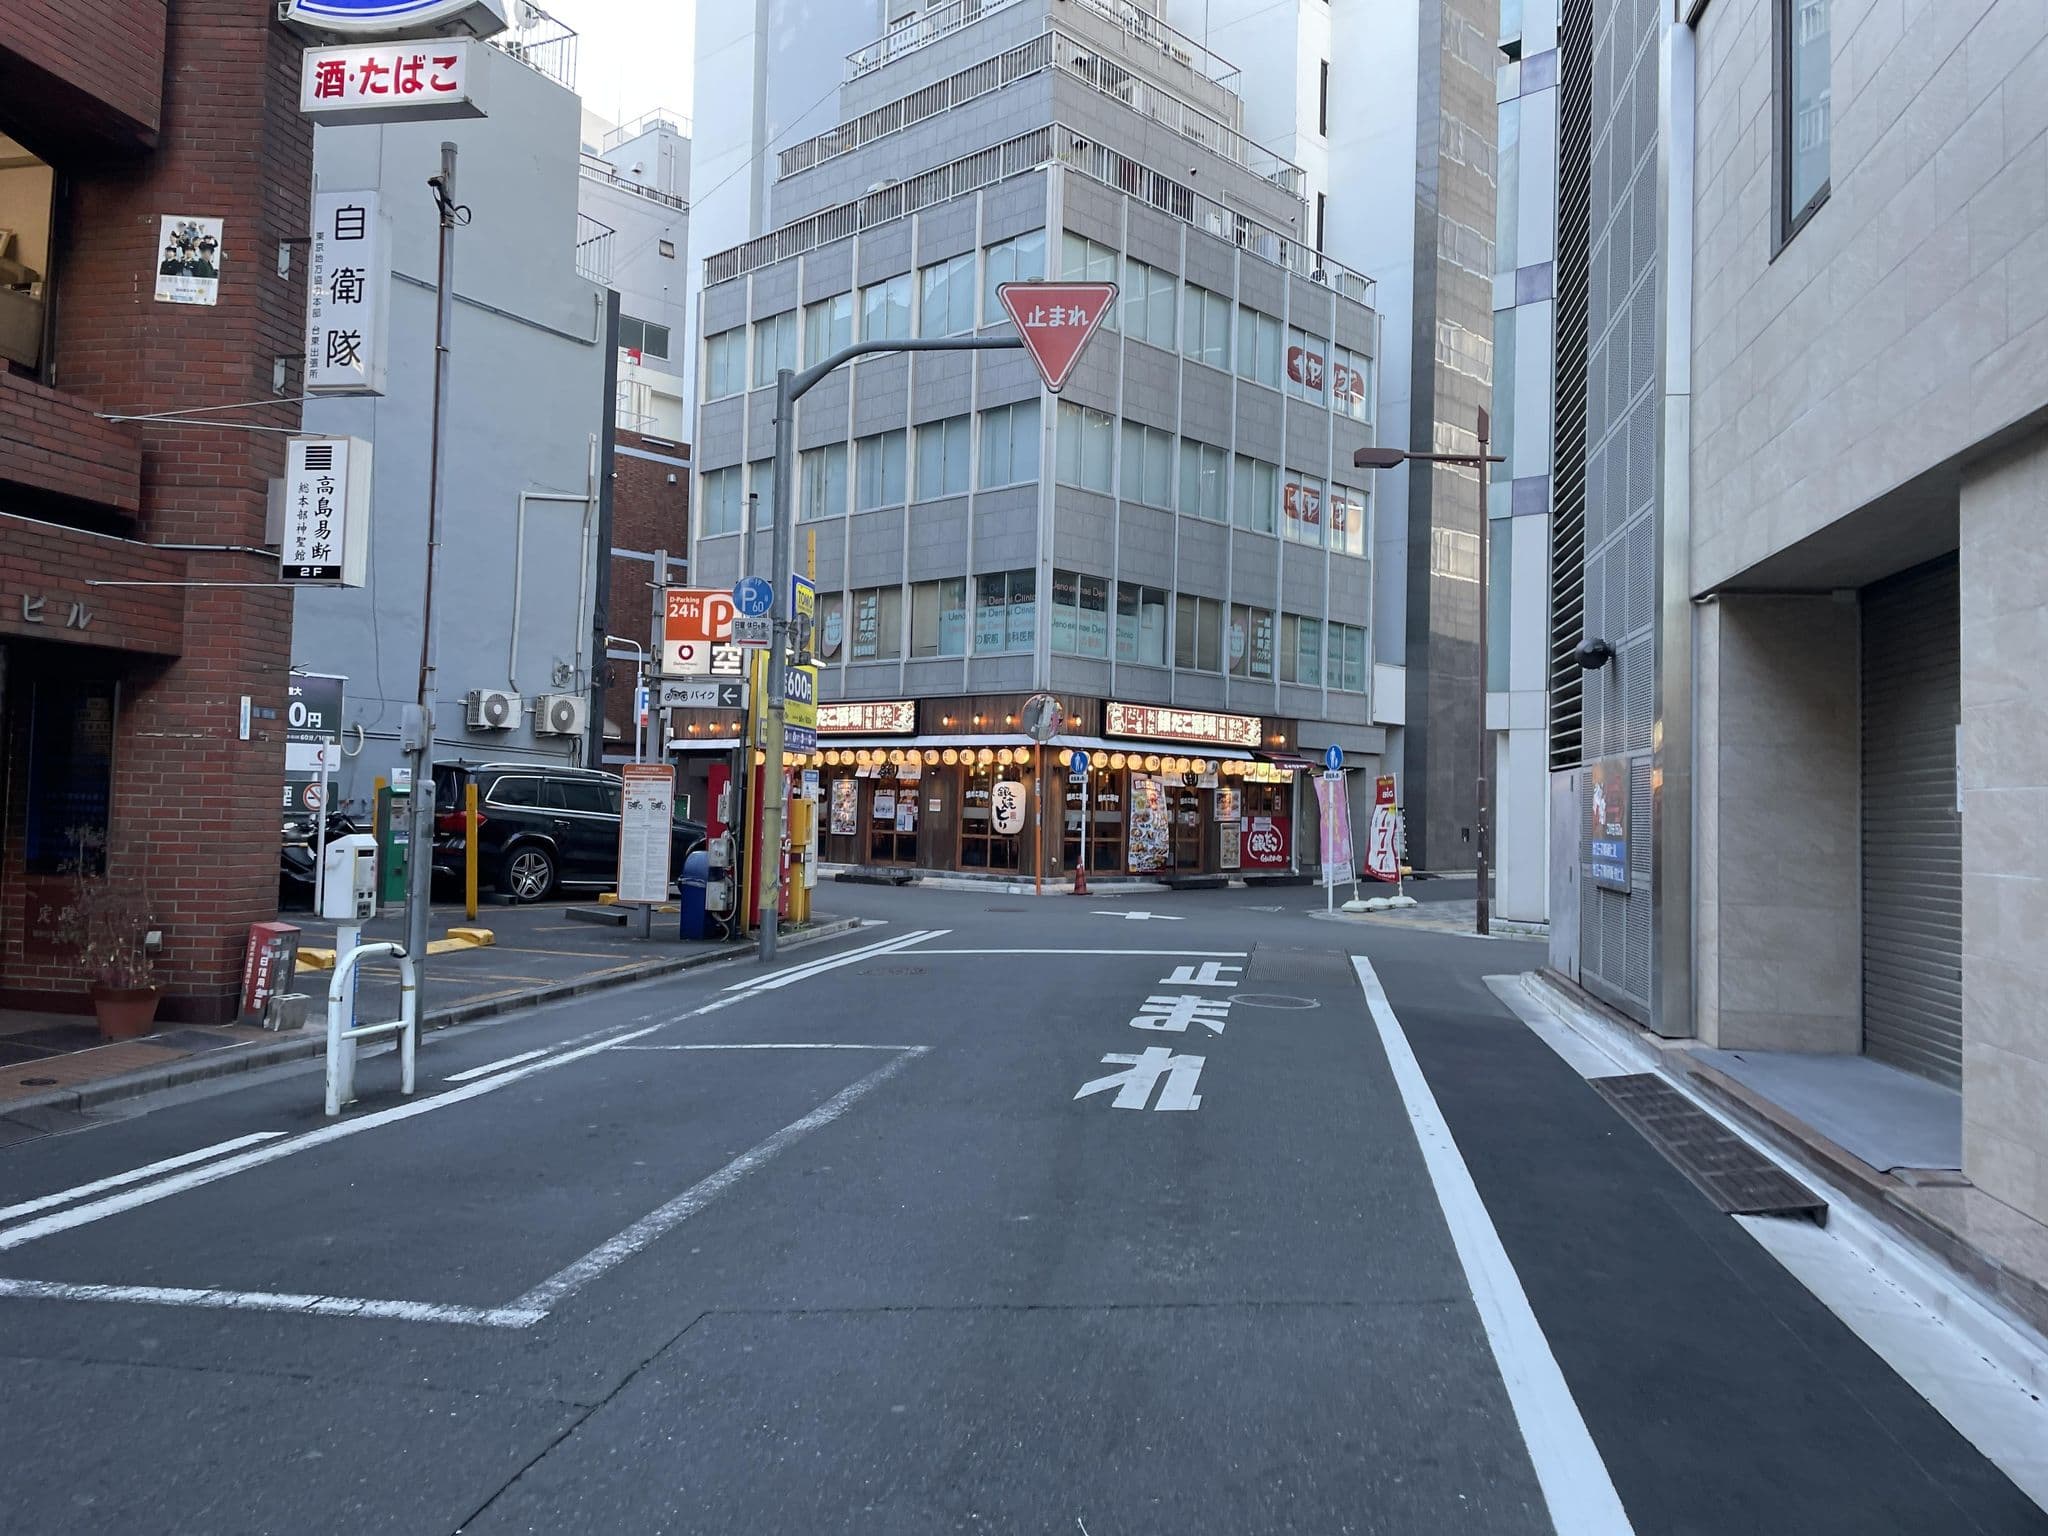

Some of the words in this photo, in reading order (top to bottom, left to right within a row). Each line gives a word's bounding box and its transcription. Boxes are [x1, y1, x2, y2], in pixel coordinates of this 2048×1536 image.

[315, 55, 458, 99] 酒・たばこ
[312, 231, 325, 318] 東京地方協力本部
[327, 204, 366, 369] 自衛隊
[1025, 304, 1089, 328] 止まれ
[309, 325, 320, 379] 台東出張所
[312, 476, 335, 562] 高島易断
[300, 568, 322, 576] 2F
[23, 593, 94, 630] ビル
[669, 596, 700, 604] D-Parking
[669, 604, 700, 618] 24h
[742, 587, 757, 612] P
[753, 601, 764, 612] 60
[988, 594, 1013, 606] Denal
[711, 643, 743, 675] 空
[690, 691, 715, 700] バイク
[288, 701, 322, 728] 0円
[1073, 961, 1243, 1112] 止まれ
